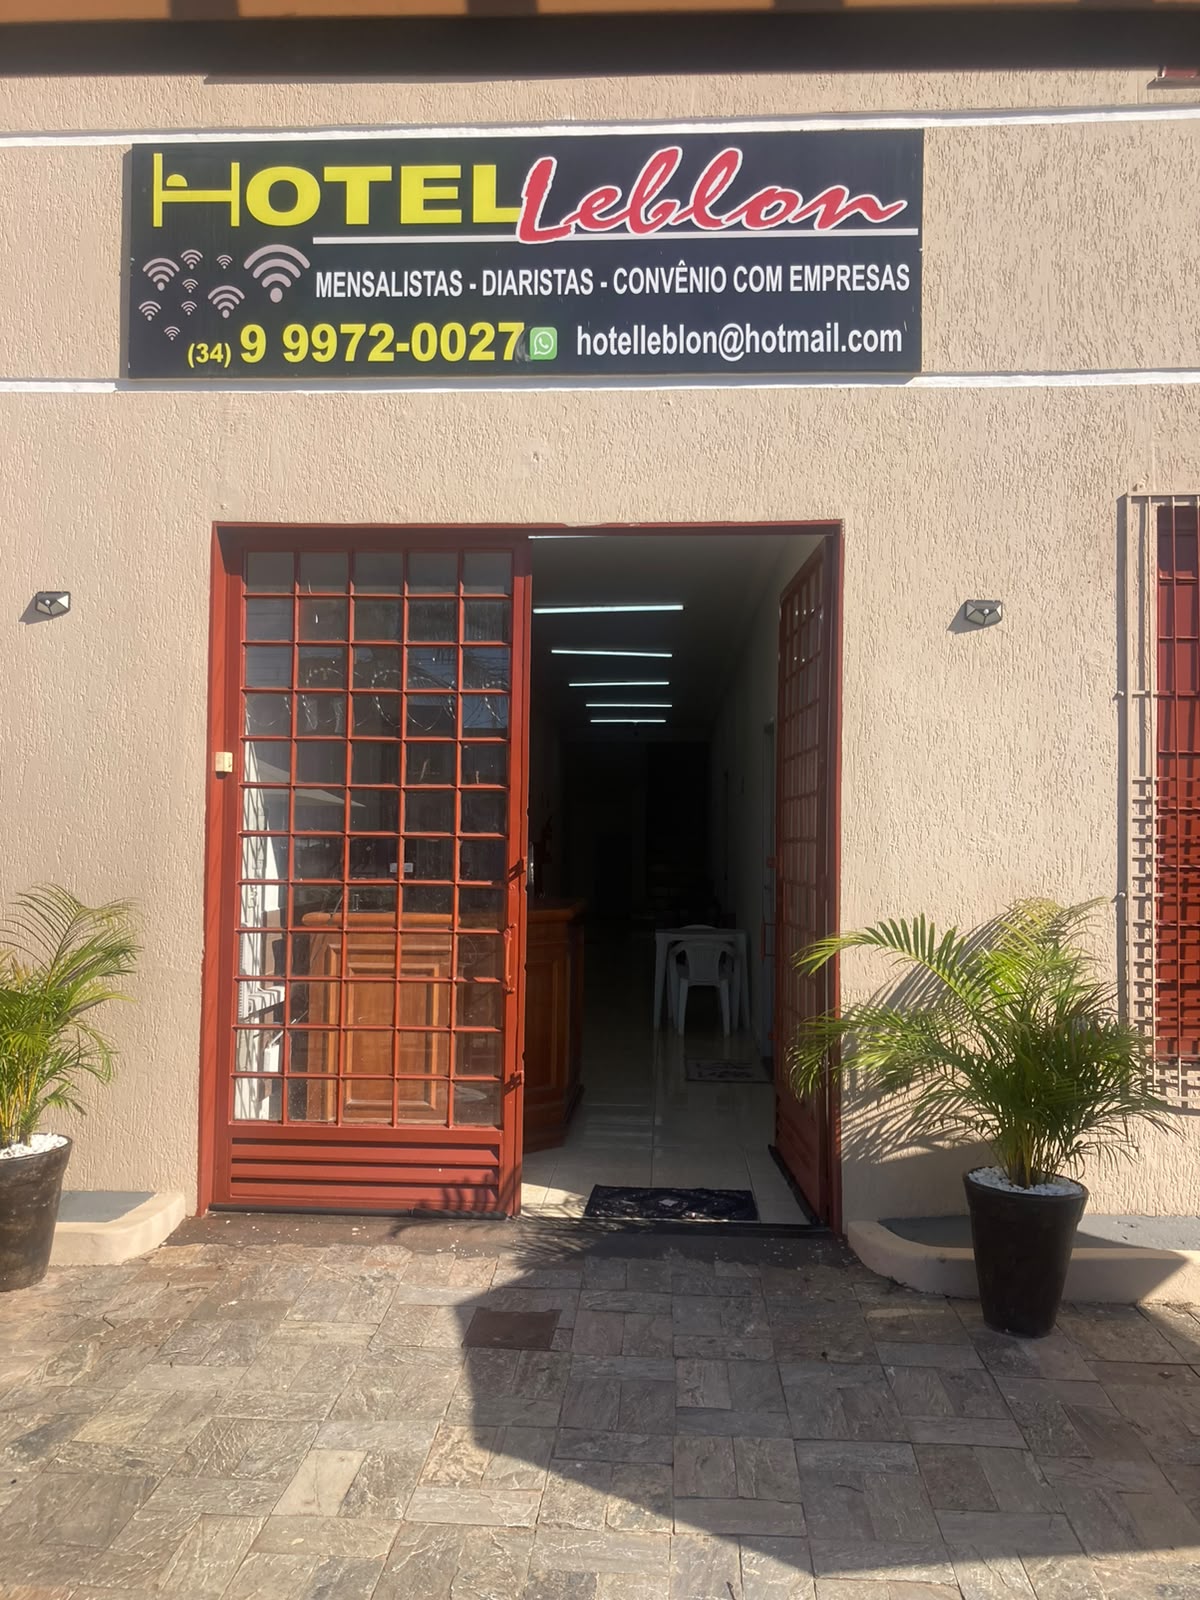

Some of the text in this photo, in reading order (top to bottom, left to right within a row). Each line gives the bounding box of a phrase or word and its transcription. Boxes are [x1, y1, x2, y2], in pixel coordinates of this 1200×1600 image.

[153, 146, 908, 244] HOTEL Leblon
[315, 270, 463, 298] MENSALISTAS
[482, 268, 594, 296] DIARISTAS
[613, 259, 727, 294] CONVÊNIO
[733, 265, 782, 293] COM
[790, 264, 910, 292] EMPRESAS
[187, 321, 902, 368] (34) 9 9972-0027 hotelleblon@hotmail.com
